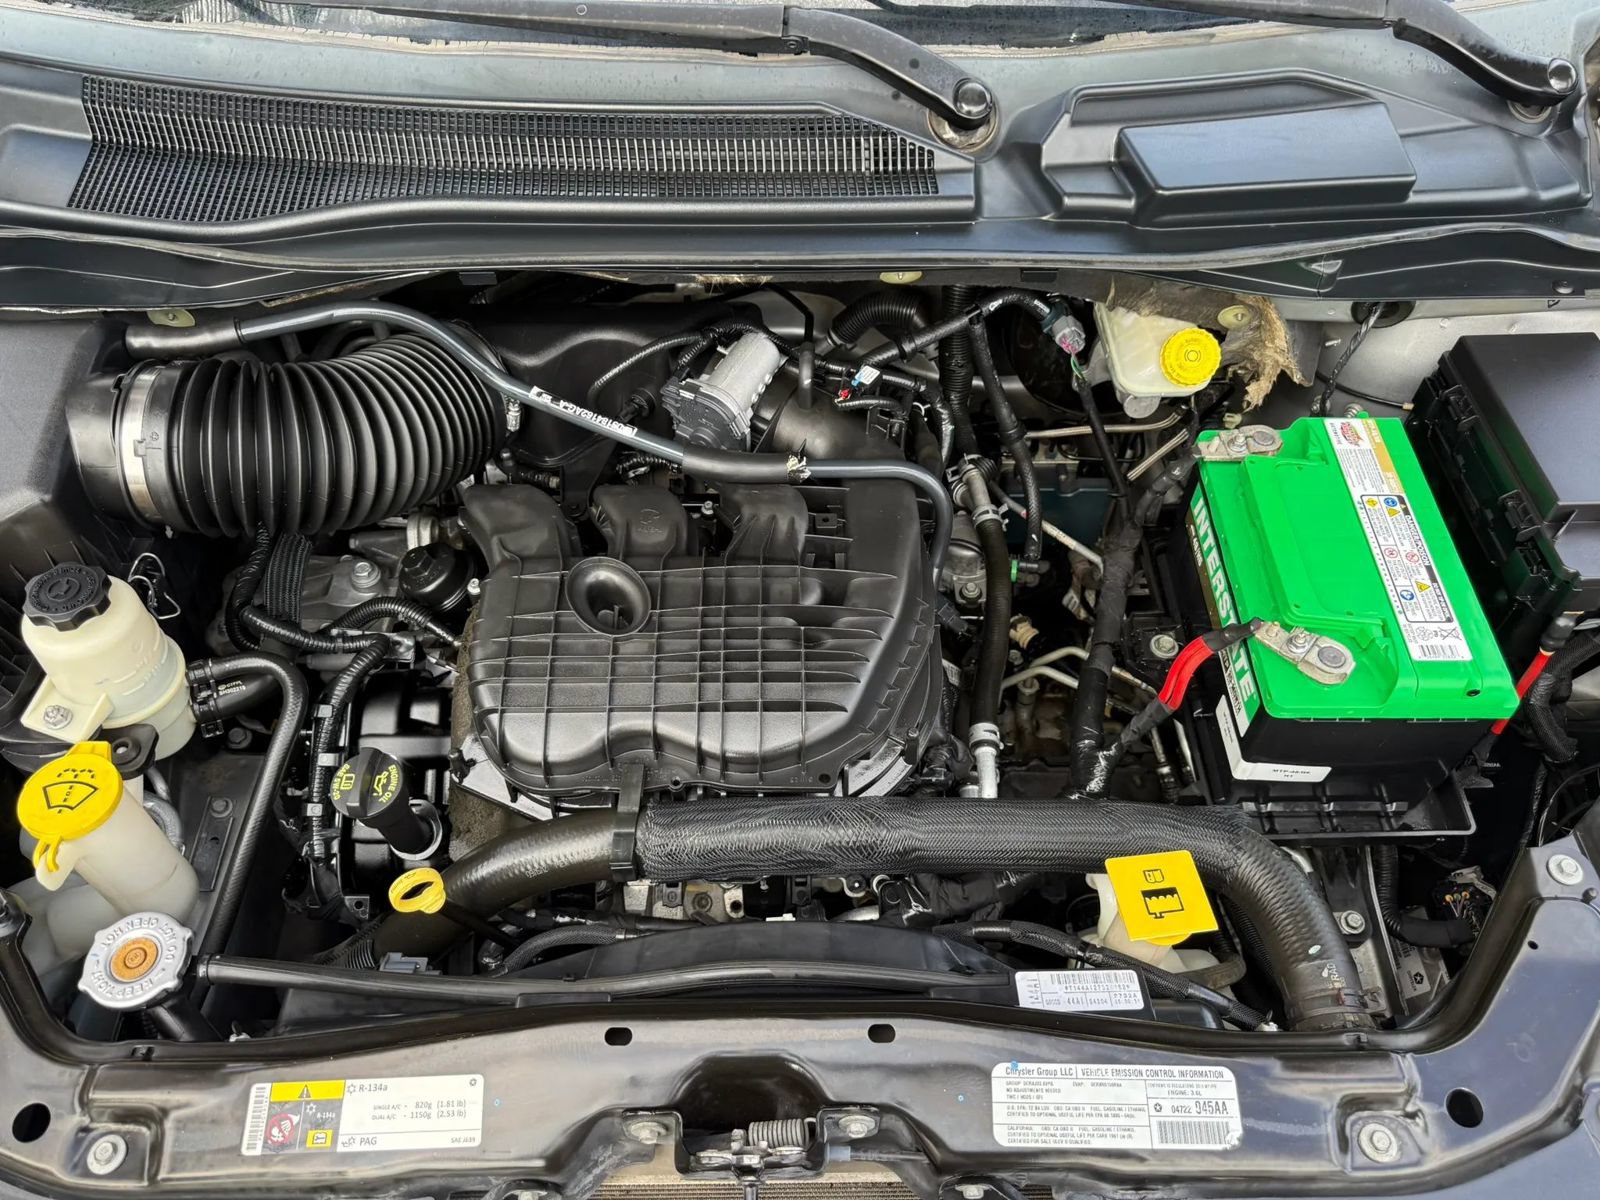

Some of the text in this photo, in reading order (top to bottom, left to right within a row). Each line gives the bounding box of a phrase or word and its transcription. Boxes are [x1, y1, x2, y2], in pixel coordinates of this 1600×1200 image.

[378, 764, 398, 803] ENGINE OIL
[126, 917, 159, 931] OPEN
[101, 926, 124, 951] HOT
[91, 970, 154, 999] KEEP TIGHT
[1036, 1067, 1058, 1077] Group
[1060, 1068, 1073, 1076] LLC
[1081, 1068, 1224, 1079] VEHICLE EMISSION CONTROL INFORMATION
[358, 1084, 388, 1092] R-134a
[415, 1101, 432, 1110] 820g
[456, 1100, 466, 1108] lb)
[1171, 1105, 1192, 1114] 04722
[410, 1111, 432, 1120] 1150g
[436, 1110, 455, 1119] (2.53
[456, 1110, 466, 1118] lb)
[359, 1137, 377, 1146] PAG
